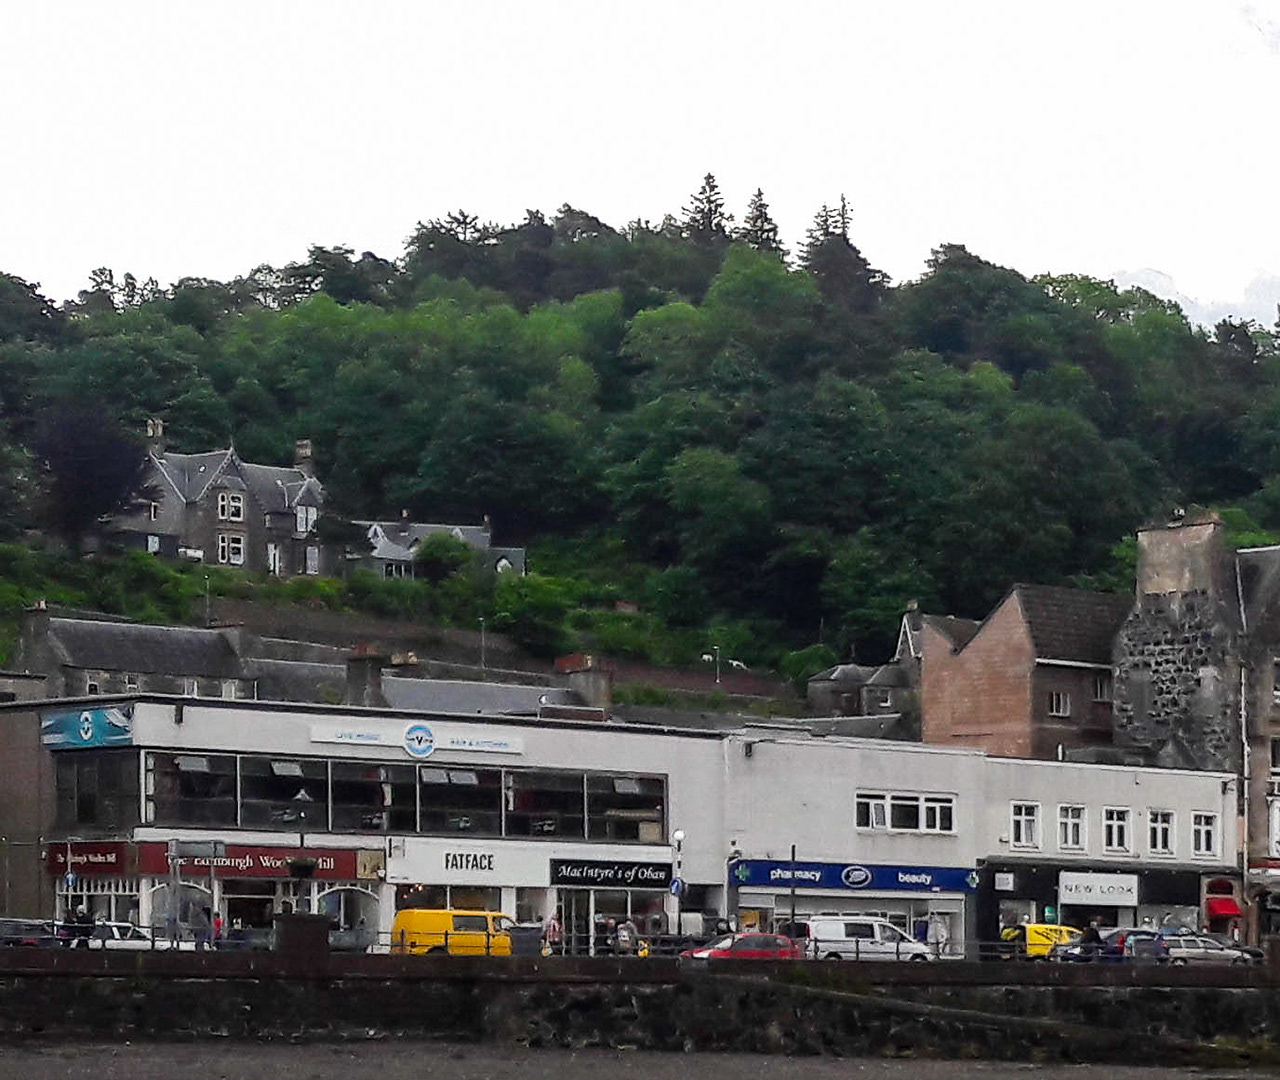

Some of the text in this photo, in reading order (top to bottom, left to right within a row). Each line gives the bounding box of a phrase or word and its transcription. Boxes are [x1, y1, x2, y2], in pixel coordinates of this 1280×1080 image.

[445, 853, 494, 870] FATFACE
[559, 864, 666, 883] MacIntyre's of Oban
[898, 872, 932, 885] beauty
[1064, 884, 1134, 895] NEW LOOK
